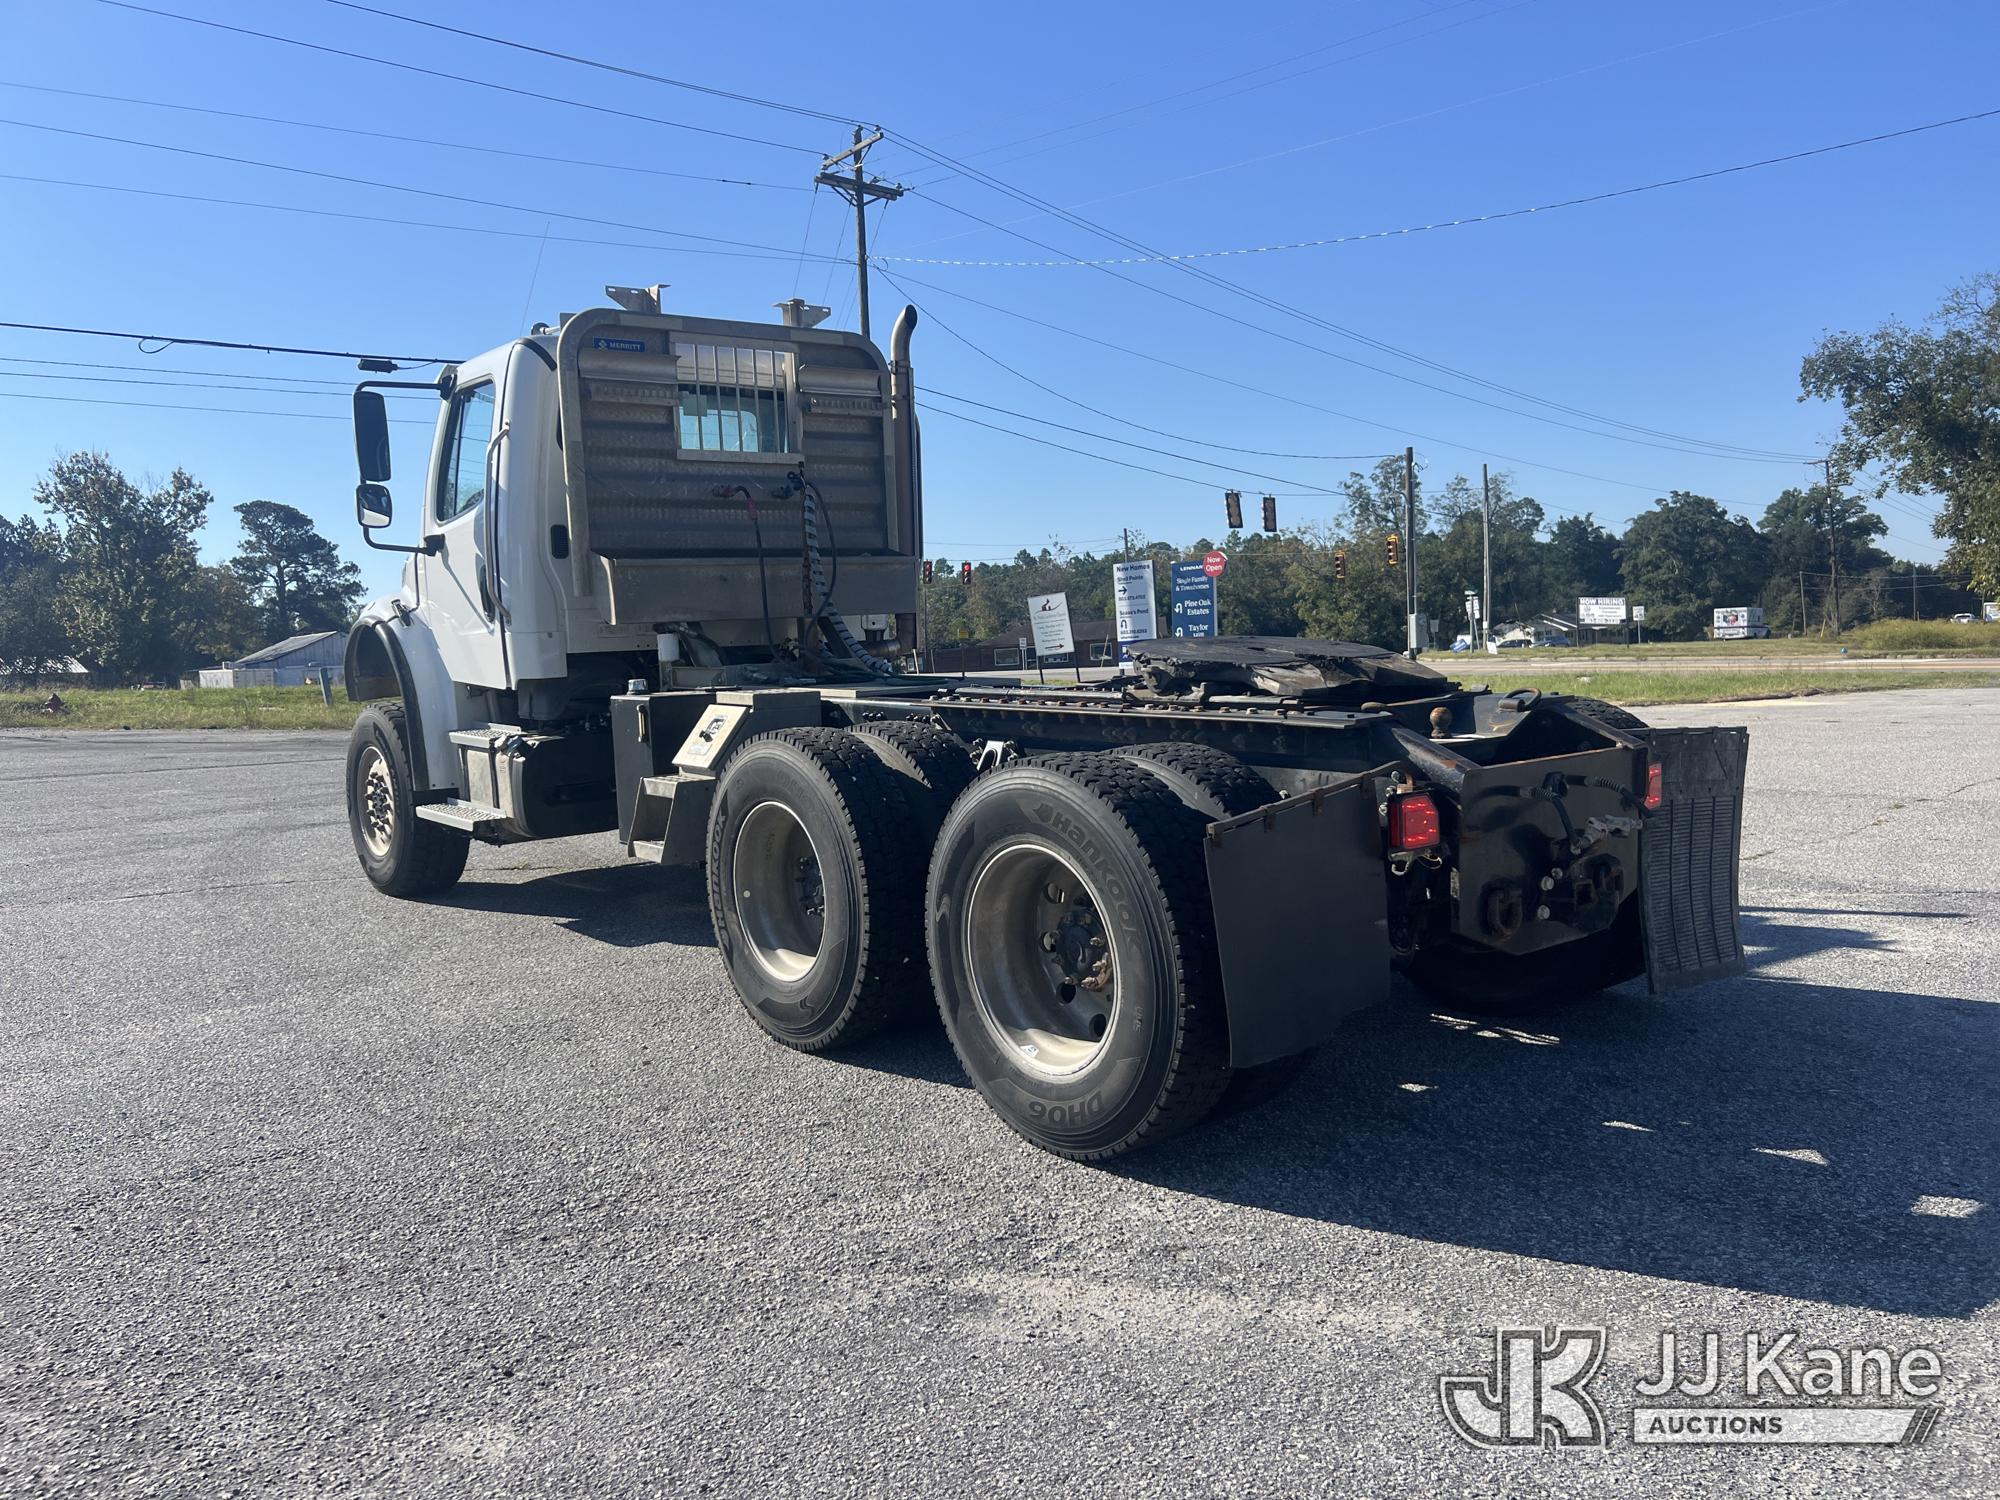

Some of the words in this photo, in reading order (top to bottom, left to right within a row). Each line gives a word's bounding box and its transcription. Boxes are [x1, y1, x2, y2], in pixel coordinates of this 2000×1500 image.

[610, 341, 640, 350] MERRITT
[1188, 624, 1208, 632] Taylor
[711, 812, 726, 928] Hankook
[1051, 811, 1139, 949] Hankook
[1028, 1090, 1104, 1127] DH06
